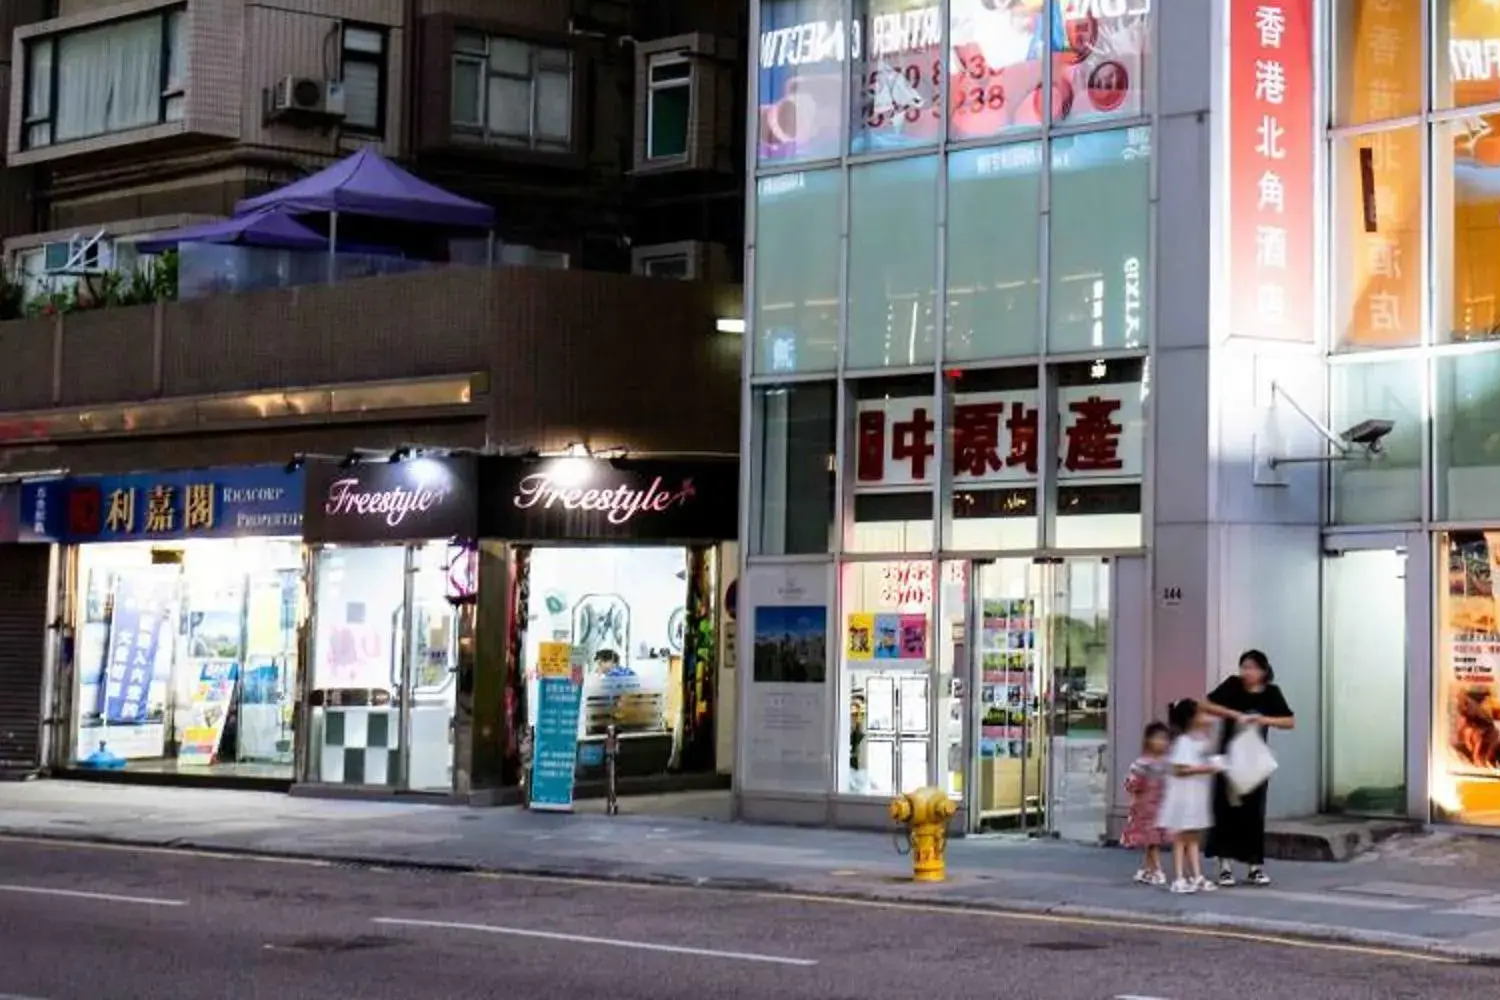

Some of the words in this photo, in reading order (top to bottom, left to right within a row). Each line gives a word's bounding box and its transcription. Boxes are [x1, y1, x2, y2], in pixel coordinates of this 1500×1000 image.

[106, 482, 215, 532] 利嘉閣
[325, 479, 432, 526] Freestyle
[514, 473, 671, 525] Freestyle
